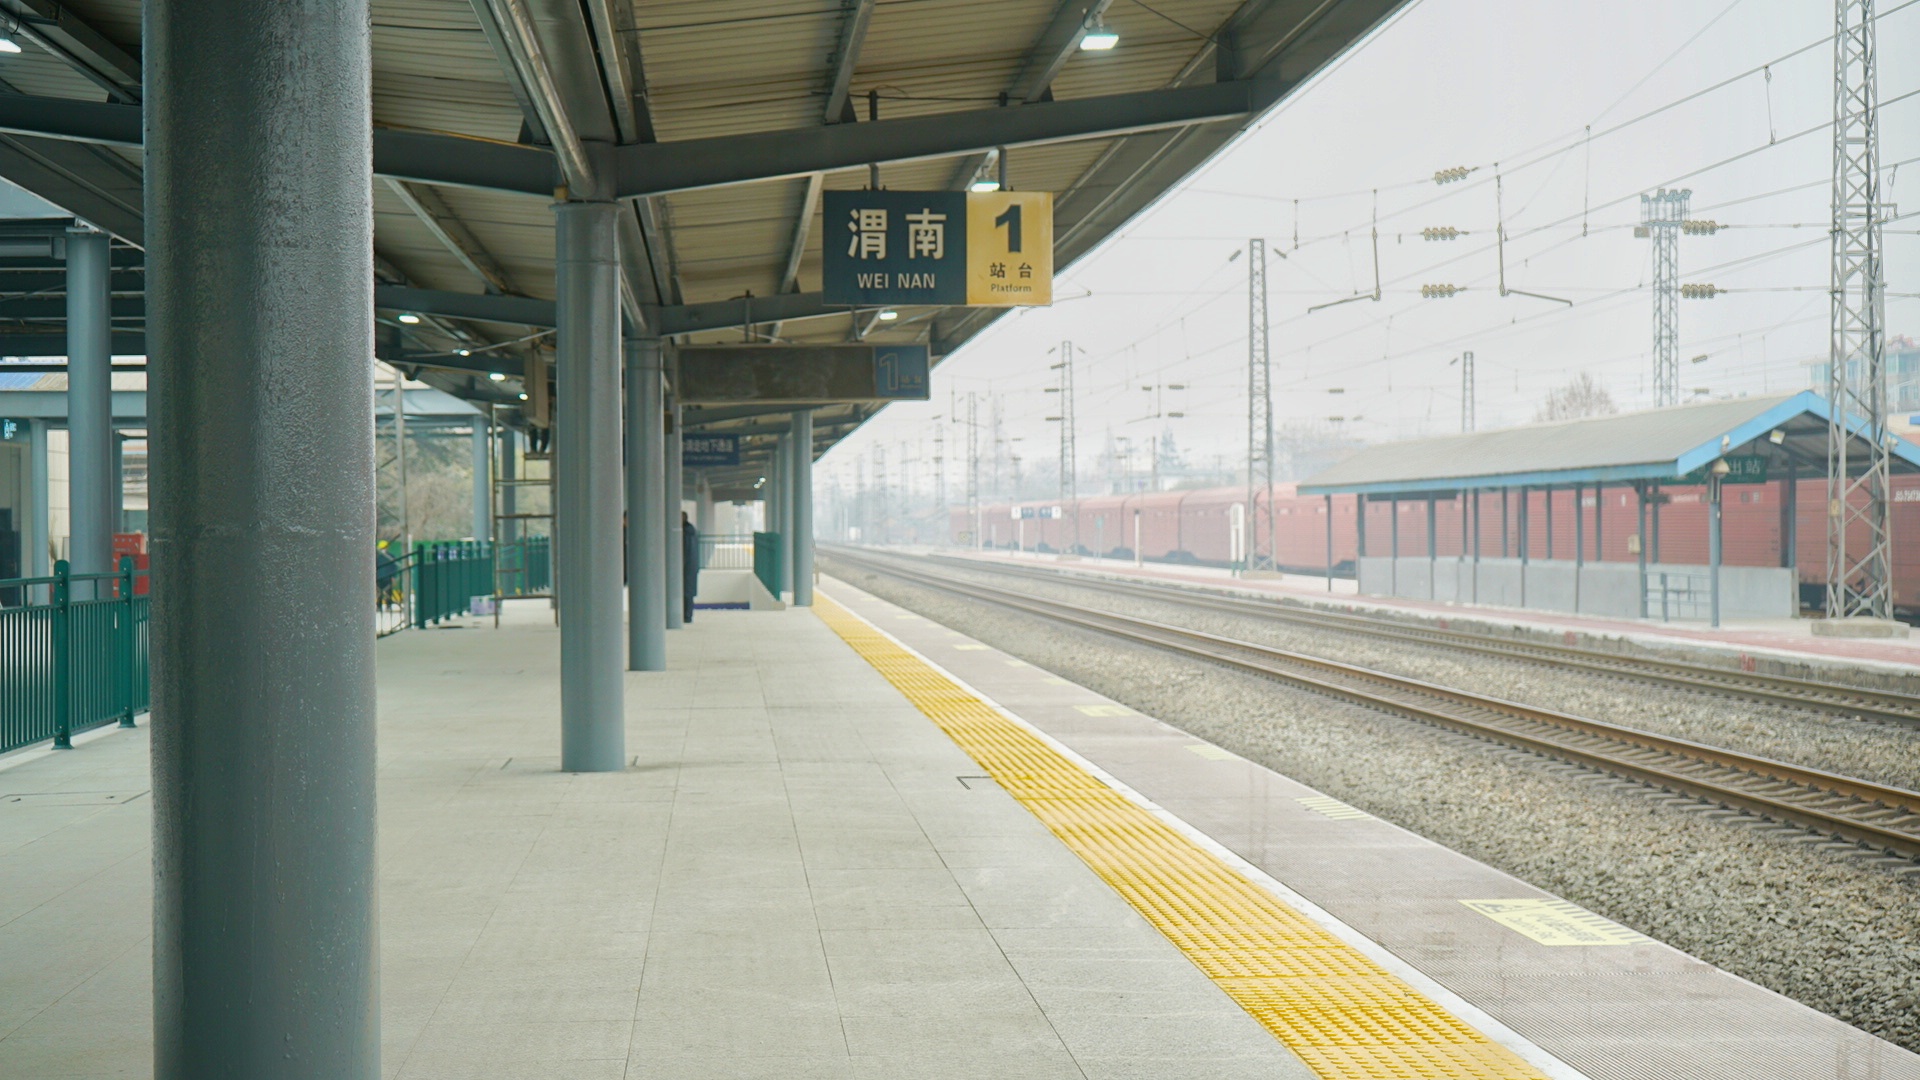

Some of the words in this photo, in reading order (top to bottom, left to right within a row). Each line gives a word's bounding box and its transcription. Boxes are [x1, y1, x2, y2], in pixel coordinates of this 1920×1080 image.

[847, 208, 947, 260] 渭南
[995, 204, 1022, 253] 1
[857, 273, 889, 289] WEI
[898, 273, 935, 289] NAN
[989, 262, 1033, 279] 站台
[990, 283, 1032, 293] Platform
[879, 353, 898, 390] 1
